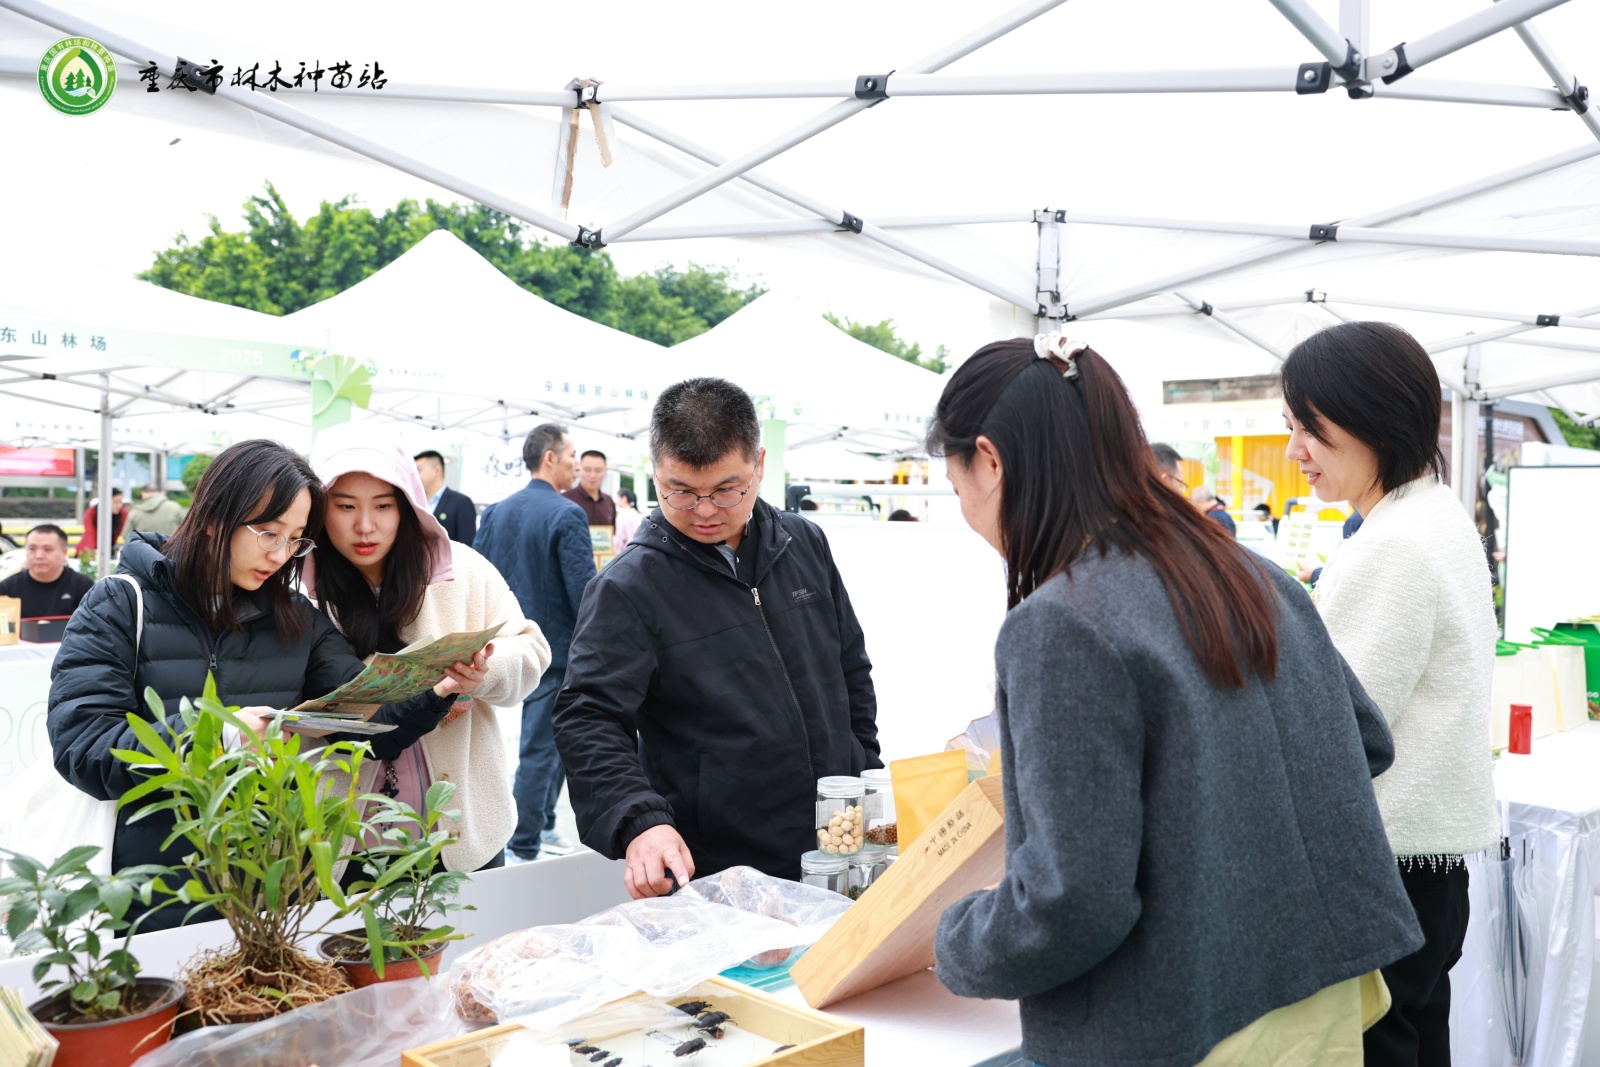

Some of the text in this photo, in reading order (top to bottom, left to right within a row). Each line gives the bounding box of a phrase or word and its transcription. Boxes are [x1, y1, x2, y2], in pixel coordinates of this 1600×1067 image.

[0, 326, 107, 351] 东山林场
[219, 347, 263, 365] 2025
[937, 842, 951, 857] MADE
[956, 822, 972, 838] CHINA
